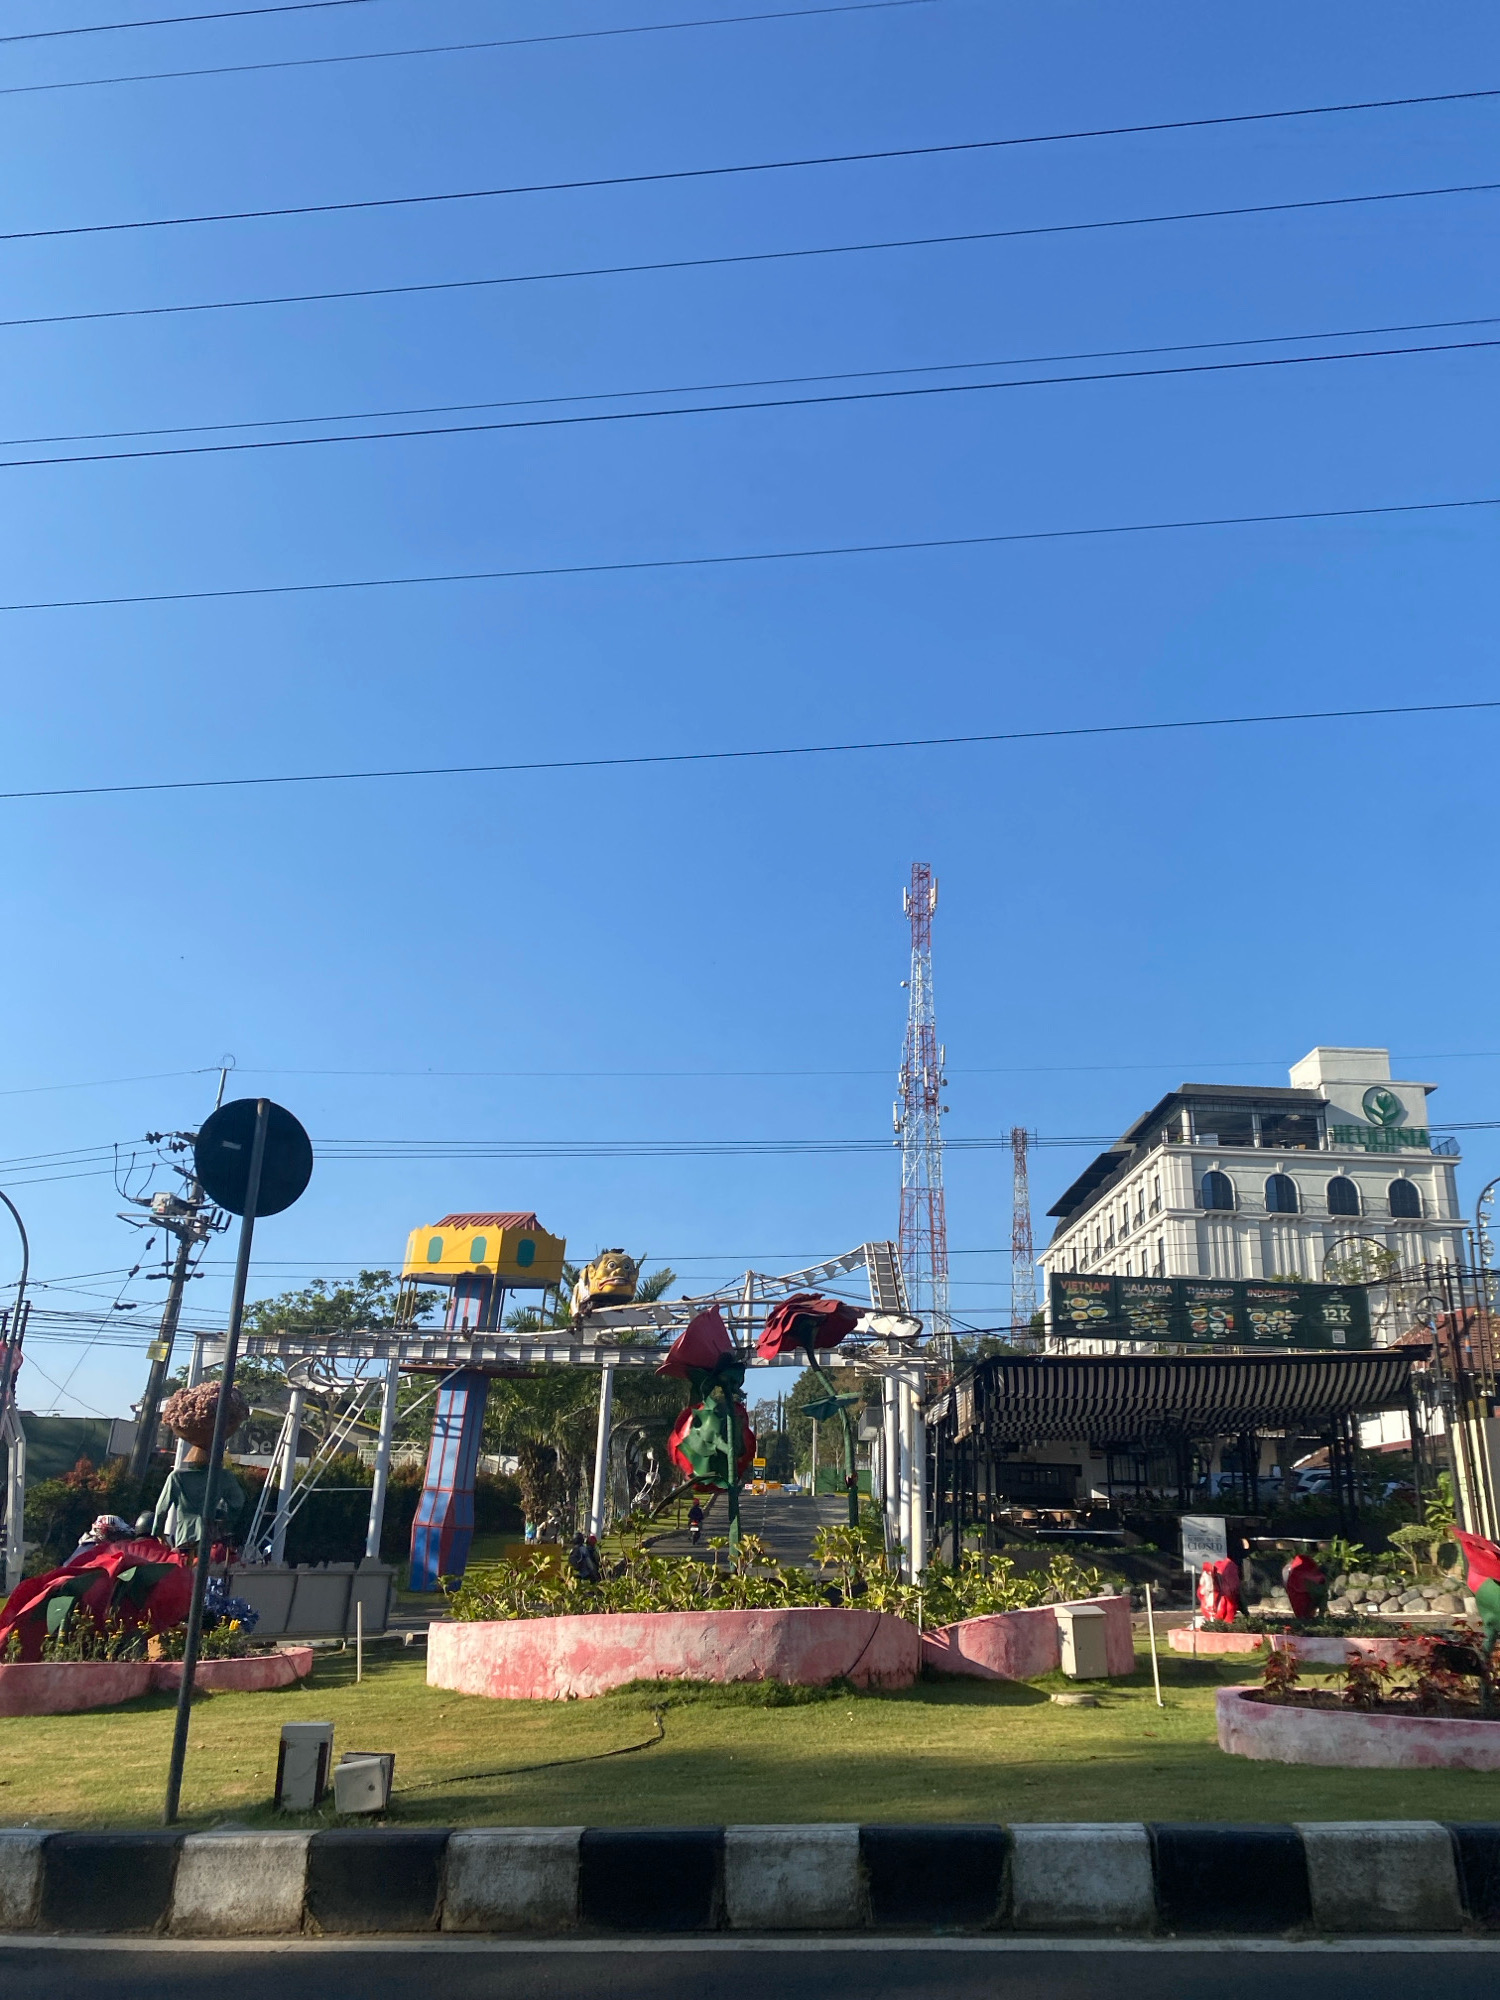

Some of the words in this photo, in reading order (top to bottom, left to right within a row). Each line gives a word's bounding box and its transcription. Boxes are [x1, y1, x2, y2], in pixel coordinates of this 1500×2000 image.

[1060, 1280, 1110, 1292] VIETNAM
[1122, 1282, 1173, 1294] MALAYSIA
[1187, 1542, 1223, 1552] CLOSED
